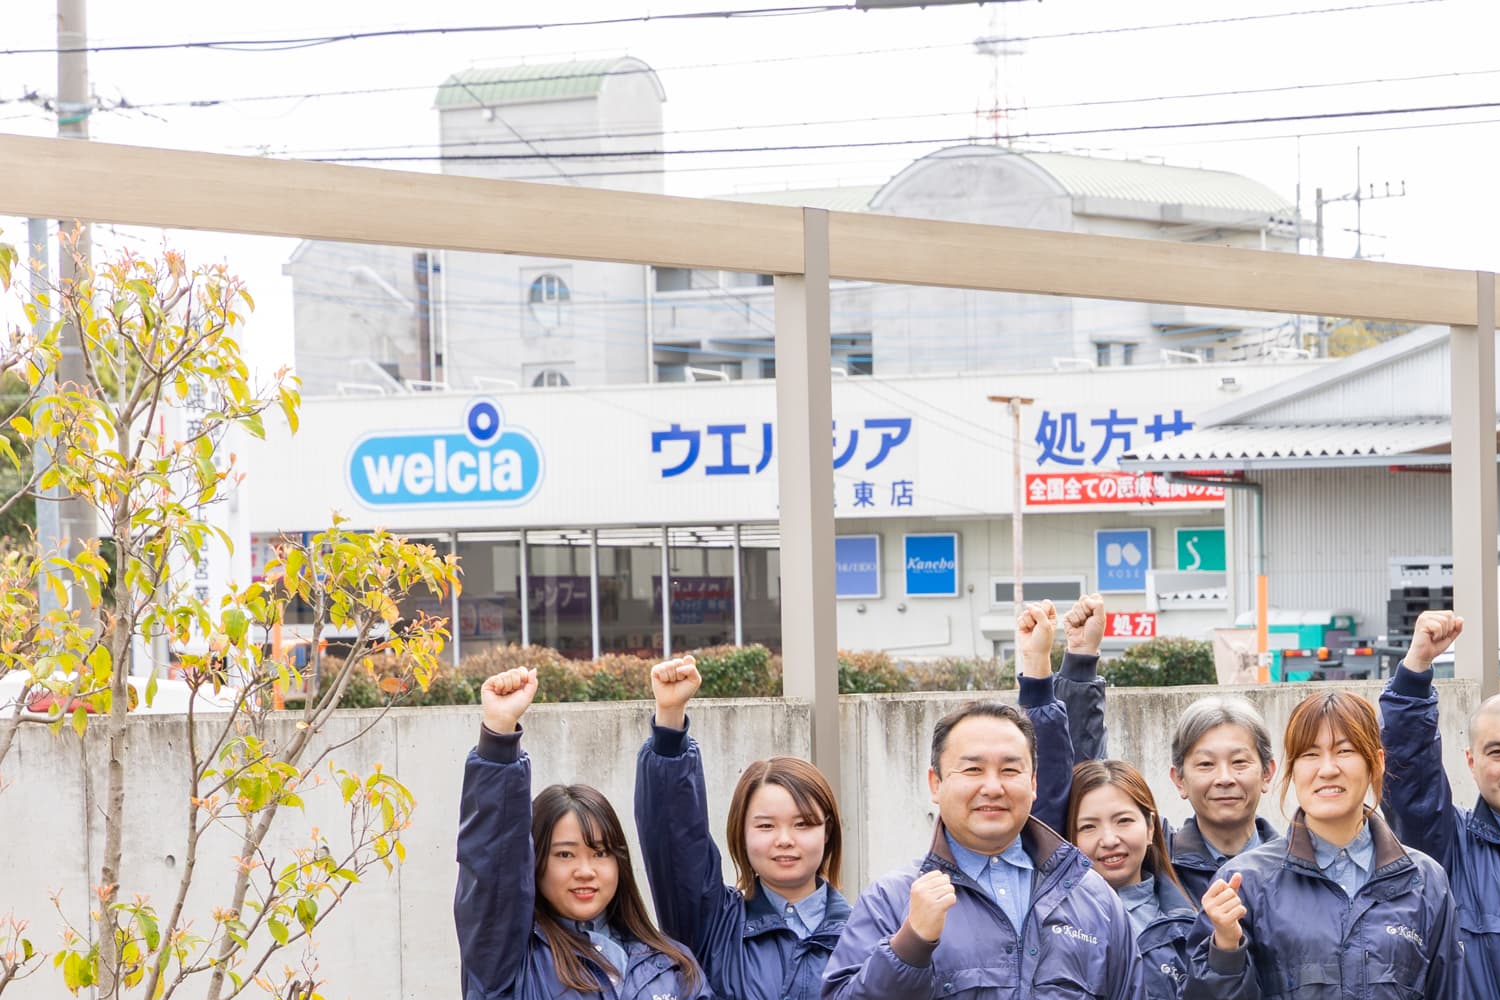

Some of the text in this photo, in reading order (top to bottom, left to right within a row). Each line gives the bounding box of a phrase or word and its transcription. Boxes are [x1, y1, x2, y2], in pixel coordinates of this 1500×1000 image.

[362, 402, 528, 495] welcia
[907, 556, 955, 571] Kanebo
[1063, 924, 1098, 945] Kalmia
